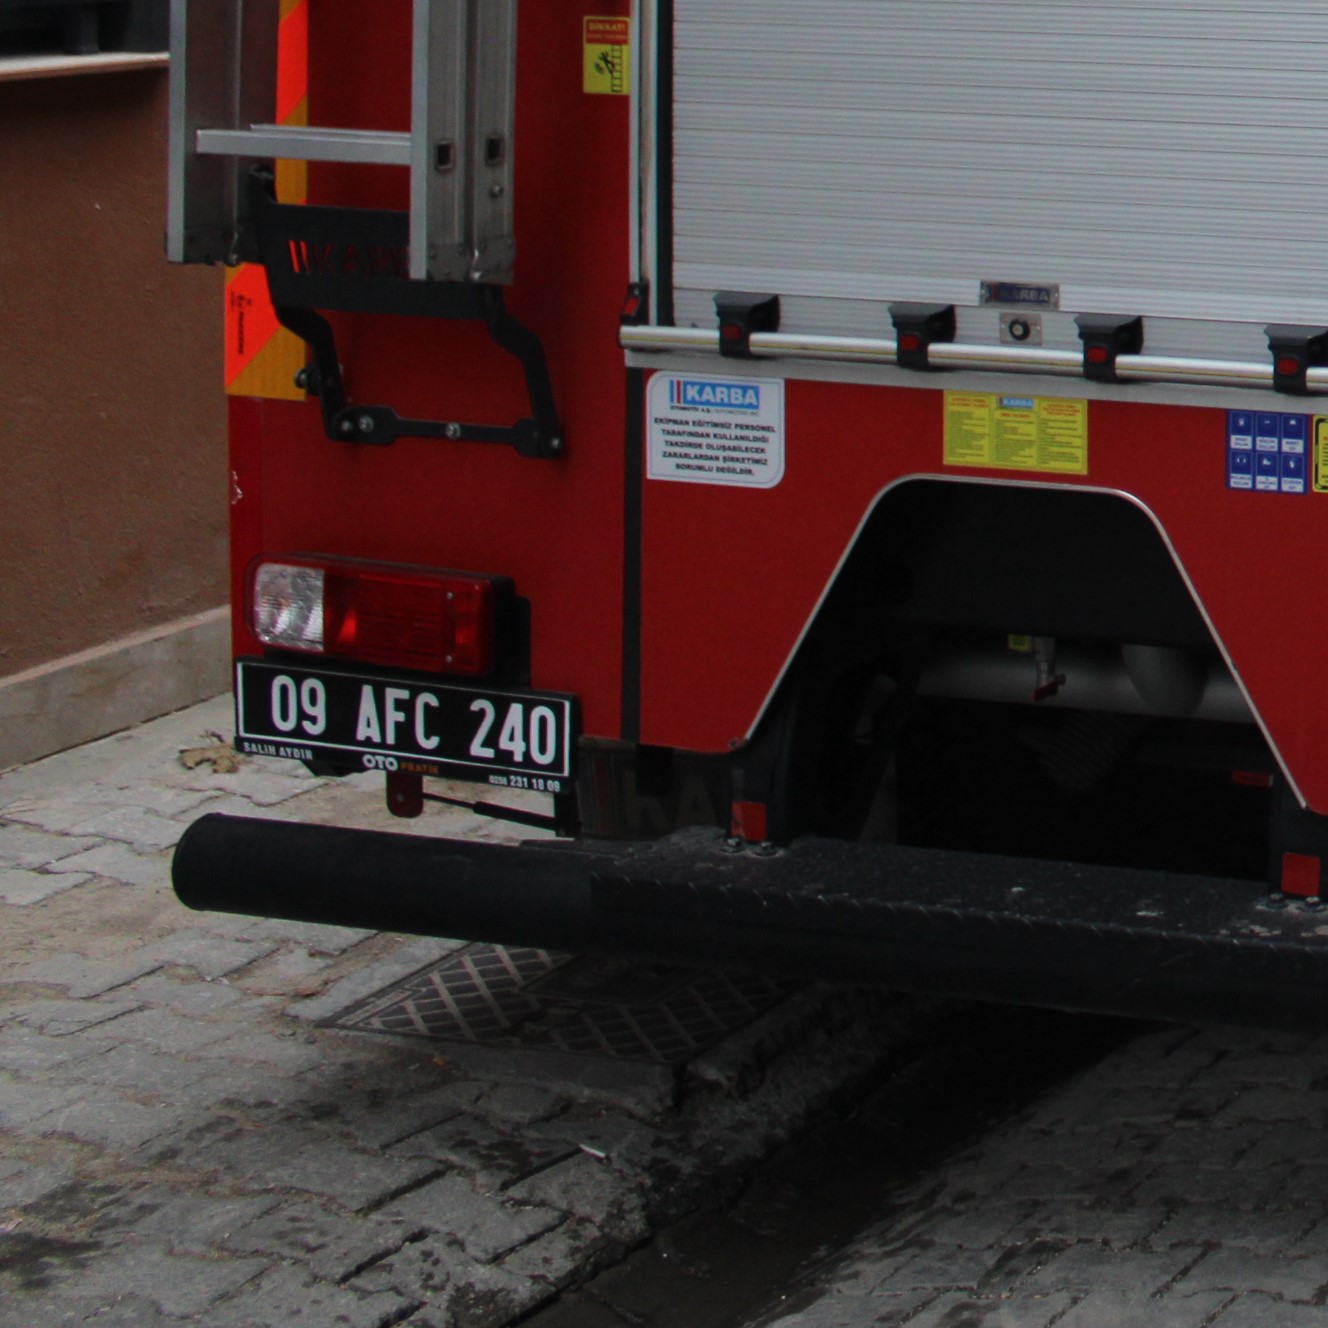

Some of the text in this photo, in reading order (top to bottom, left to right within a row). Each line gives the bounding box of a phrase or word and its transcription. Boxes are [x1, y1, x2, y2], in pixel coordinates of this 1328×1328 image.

[684, 384, 758, 406] KARBA
[270, 674, 557, 766] 09 AFC 240
[278, 745, 313, 761] AYDIN
[362, 754, 399, 771] OTO
[509, 775, 529, 789] 231
[547, 779, 561, 793] 09
